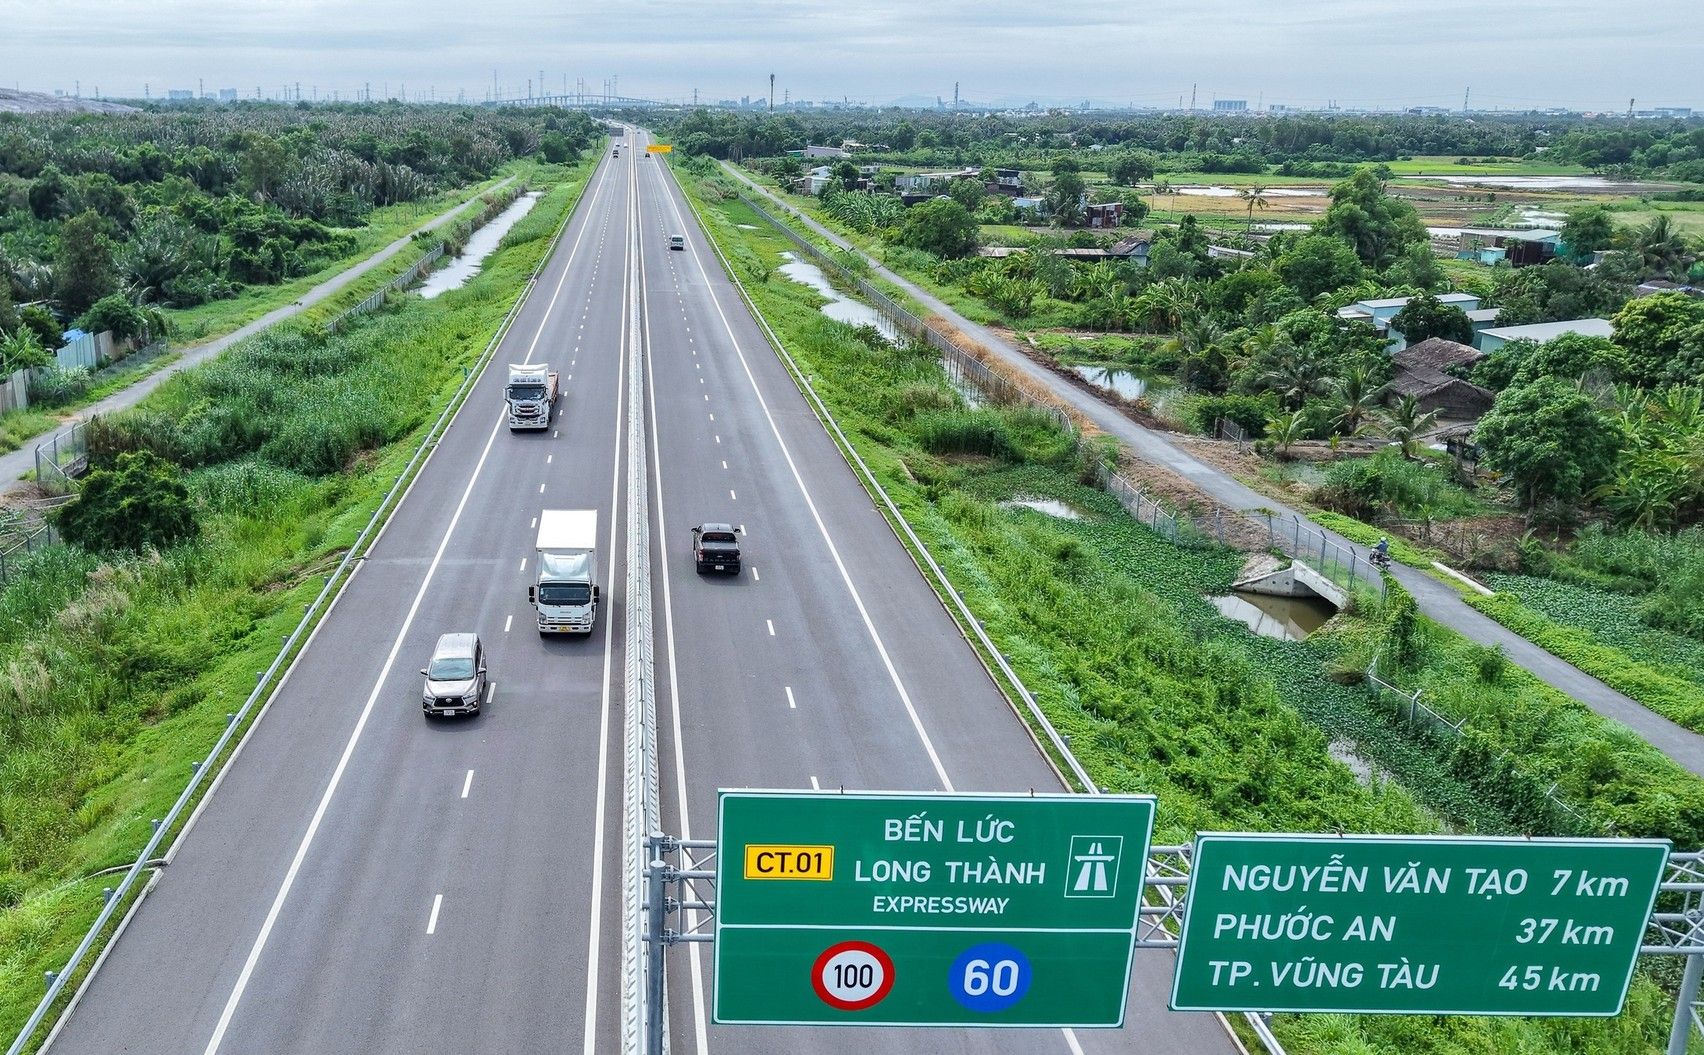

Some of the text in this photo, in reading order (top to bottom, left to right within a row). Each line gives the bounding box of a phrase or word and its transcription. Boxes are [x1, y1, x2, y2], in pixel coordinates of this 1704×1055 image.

[884, 811, 1015, 843] BẾN LỨC
[756, 851, 822, 874] CT.01
[855, 855, 1046, 884] LONG THÀNH
[1222, 853, 1629, 900] NGUYỄN VĂN TẠO 7 km
[873, 895, 1010, 914] EXPRESSWAY
[1213, 905, 1614, 945] PHƯỚC AN 37 km
[834, 963, 874, 989] 100
[963, 959, 1019, 997] 60
[1208, 956, 1601, 992] TP. VŨNG TÀU 45 km
